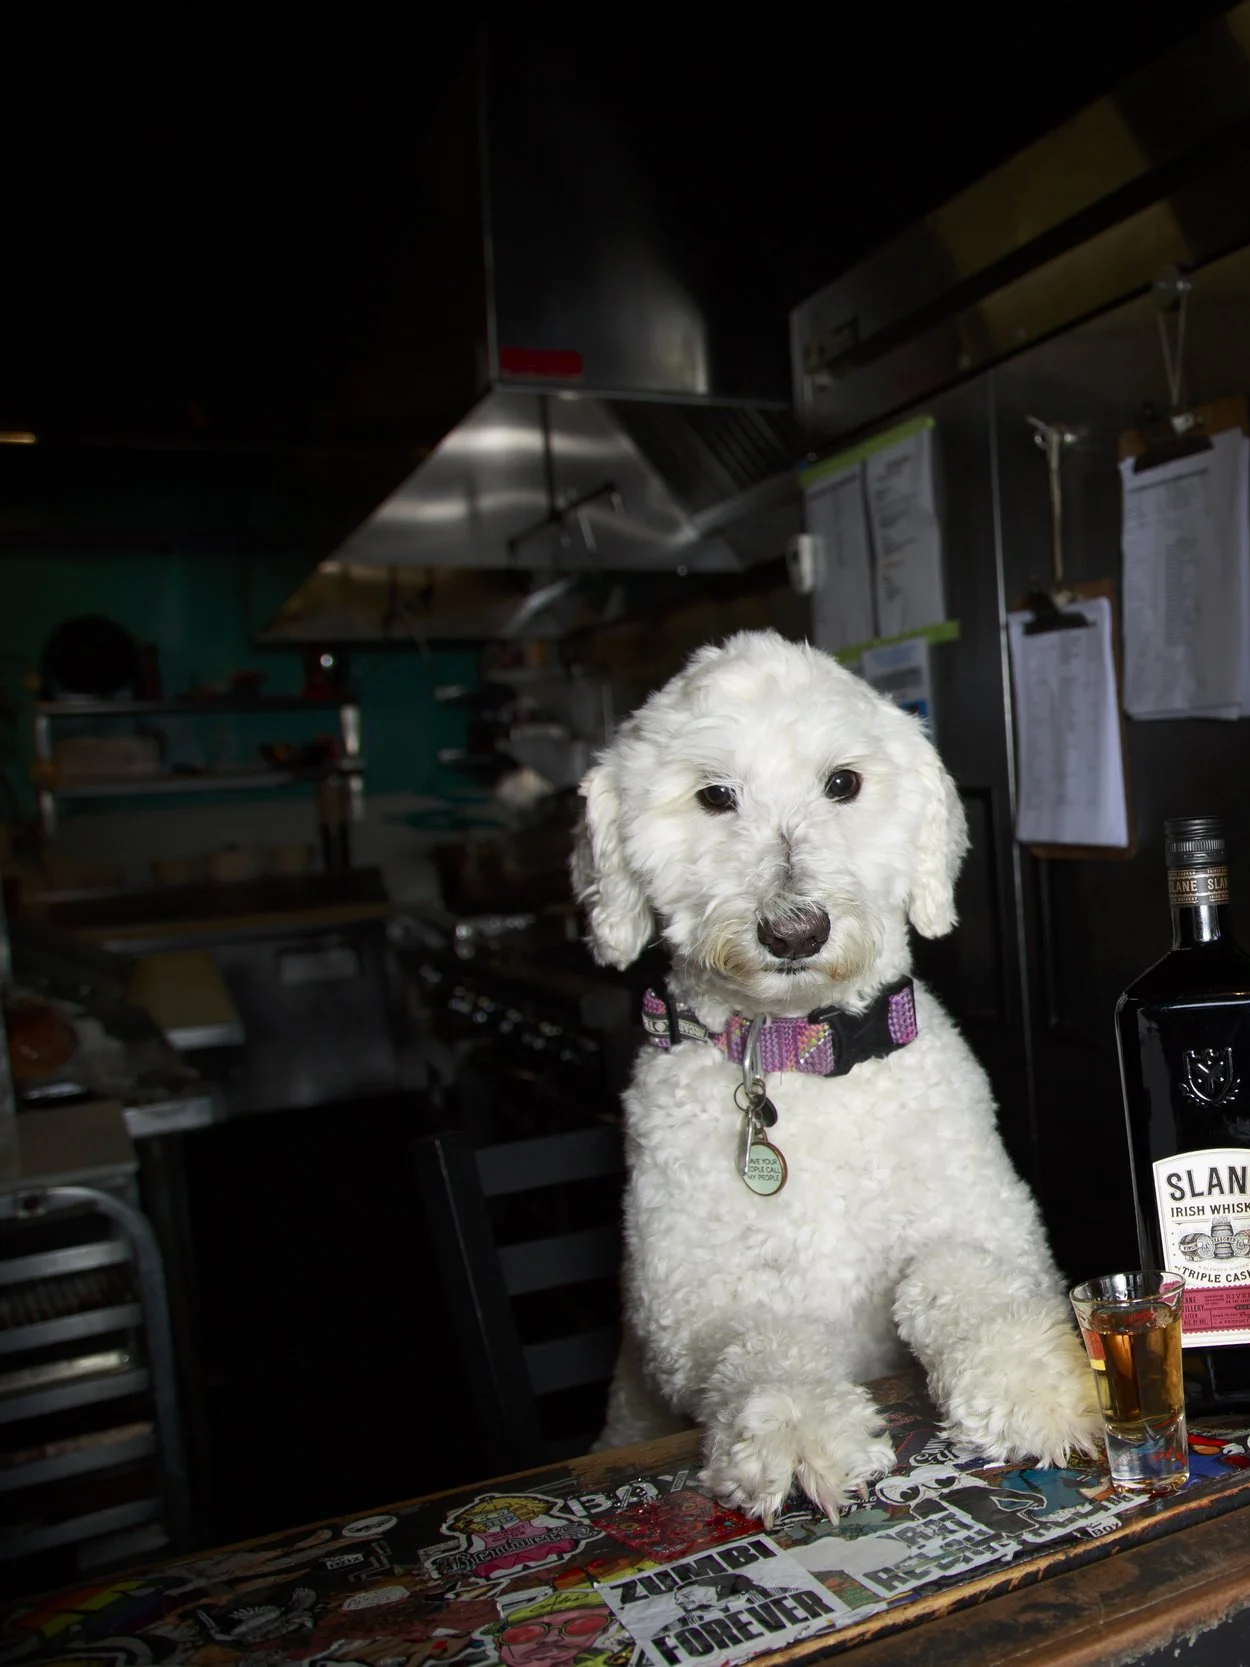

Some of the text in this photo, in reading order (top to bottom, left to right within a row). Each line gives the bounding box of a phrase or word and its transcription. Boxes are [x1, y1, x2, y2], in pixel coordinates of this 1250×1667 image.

[1169, 880, 1198, 894] LANE
[1171, 1206, 1205, 1217] IRISH
[1182, 1266, 1222, 1283] TRIPLE
[610, 1539, 777, 1604] ZUMBI
[651, 1590, 836, 1665] FOREVER
